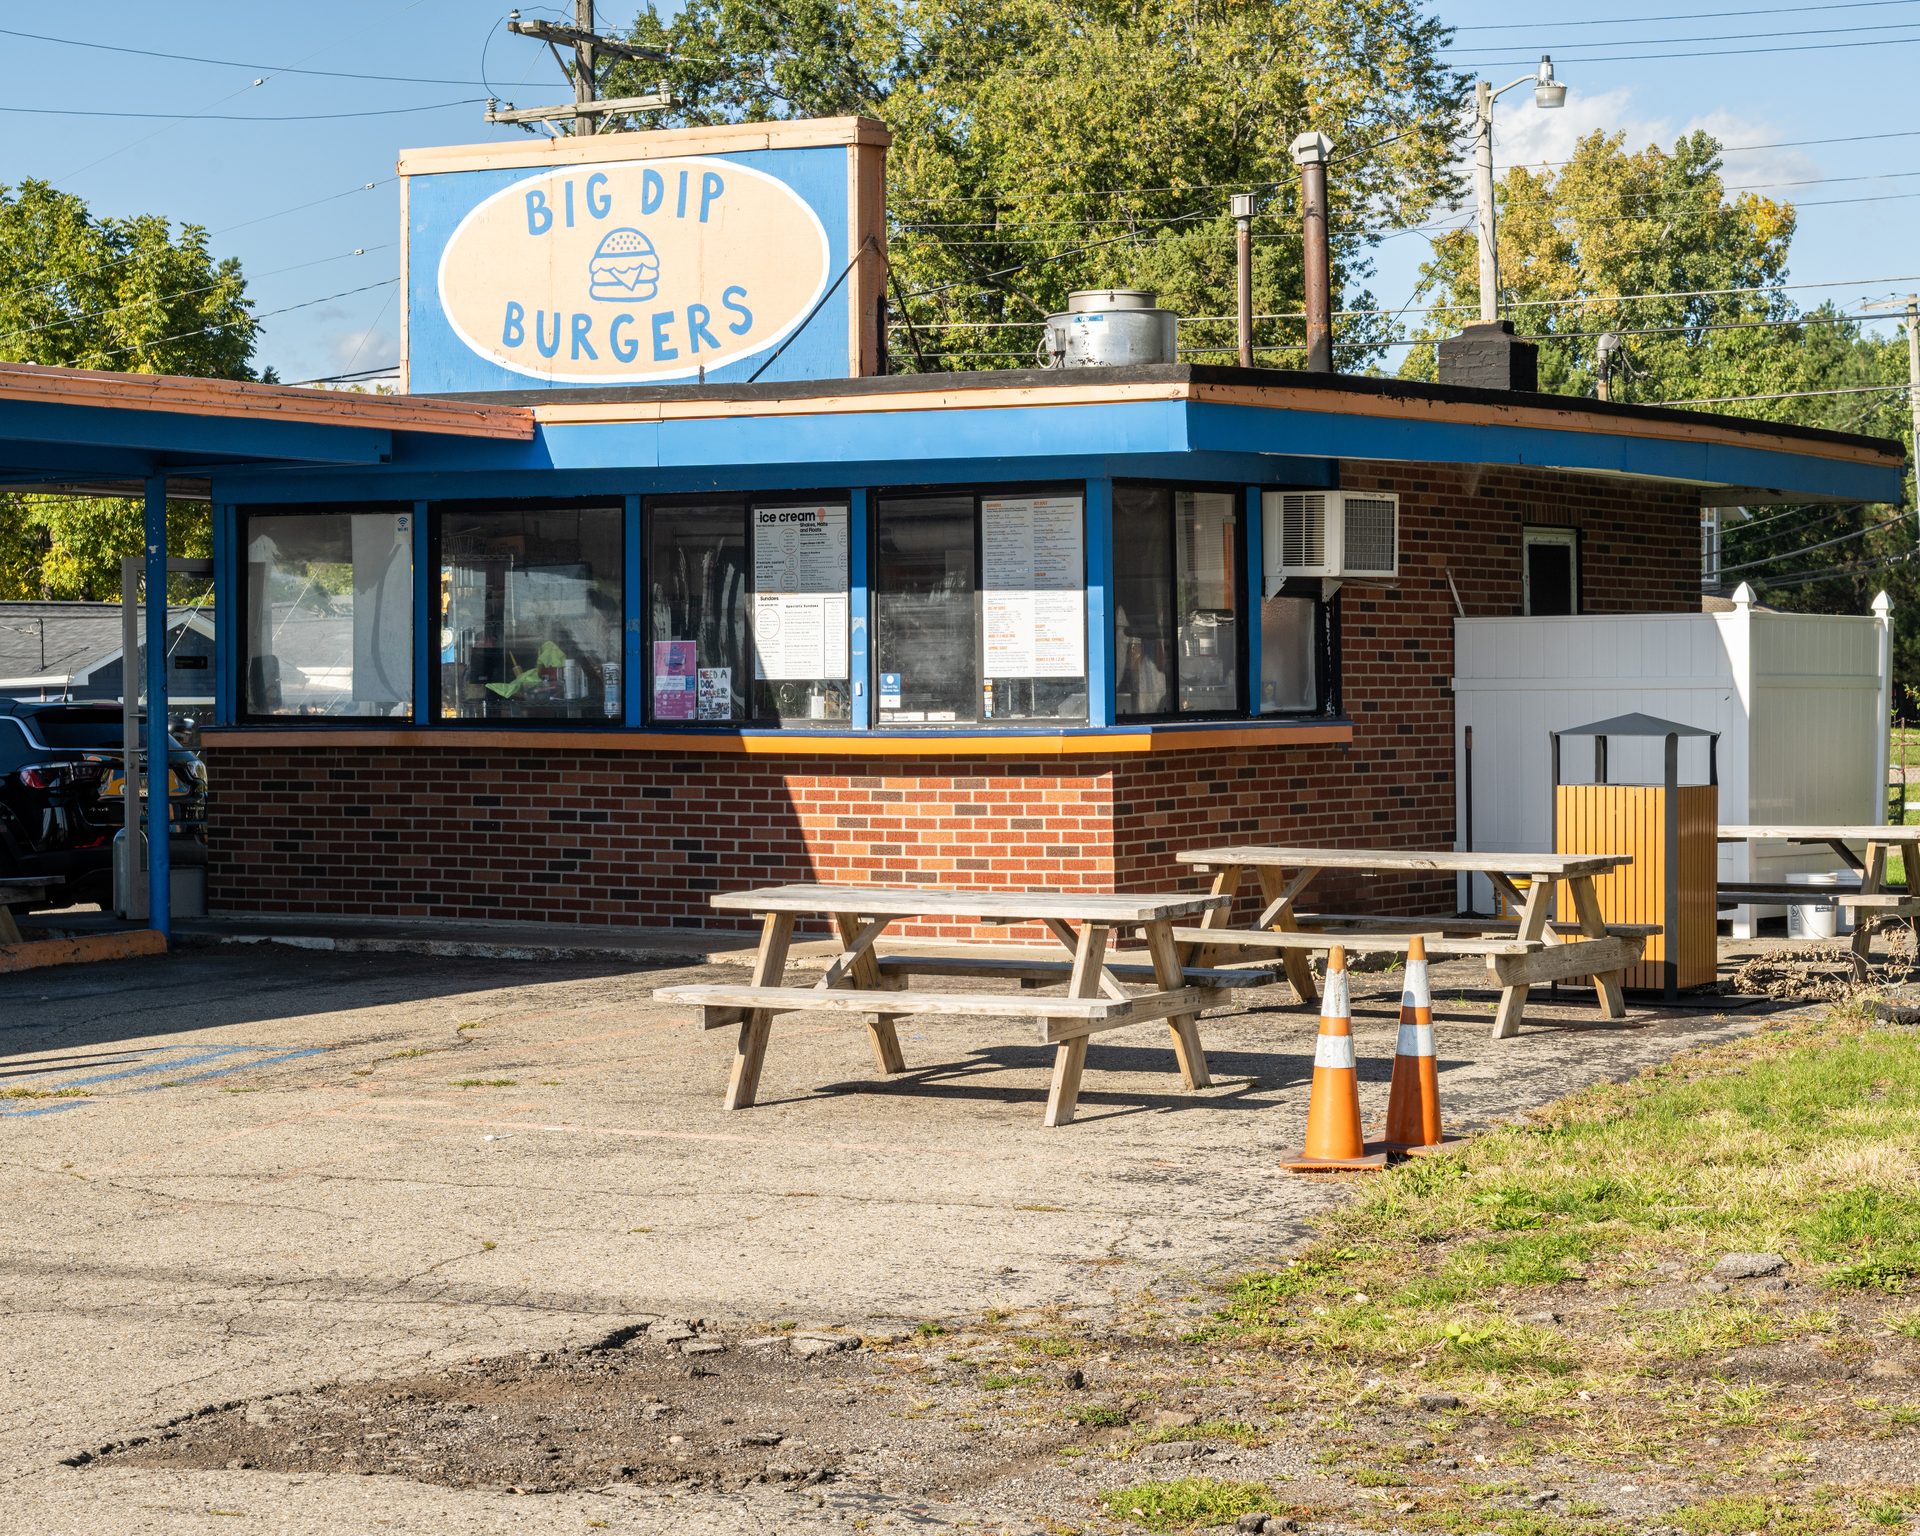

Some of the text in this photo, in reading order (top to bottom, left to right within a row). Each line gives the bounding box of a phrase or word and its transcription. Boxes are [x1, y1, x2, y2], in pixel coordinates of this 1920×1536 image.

[525, 168, 724, 236] BIG DIP
[501, 285, 753, 364] BURGERS
[760, 512, 815, 523] ice cream
